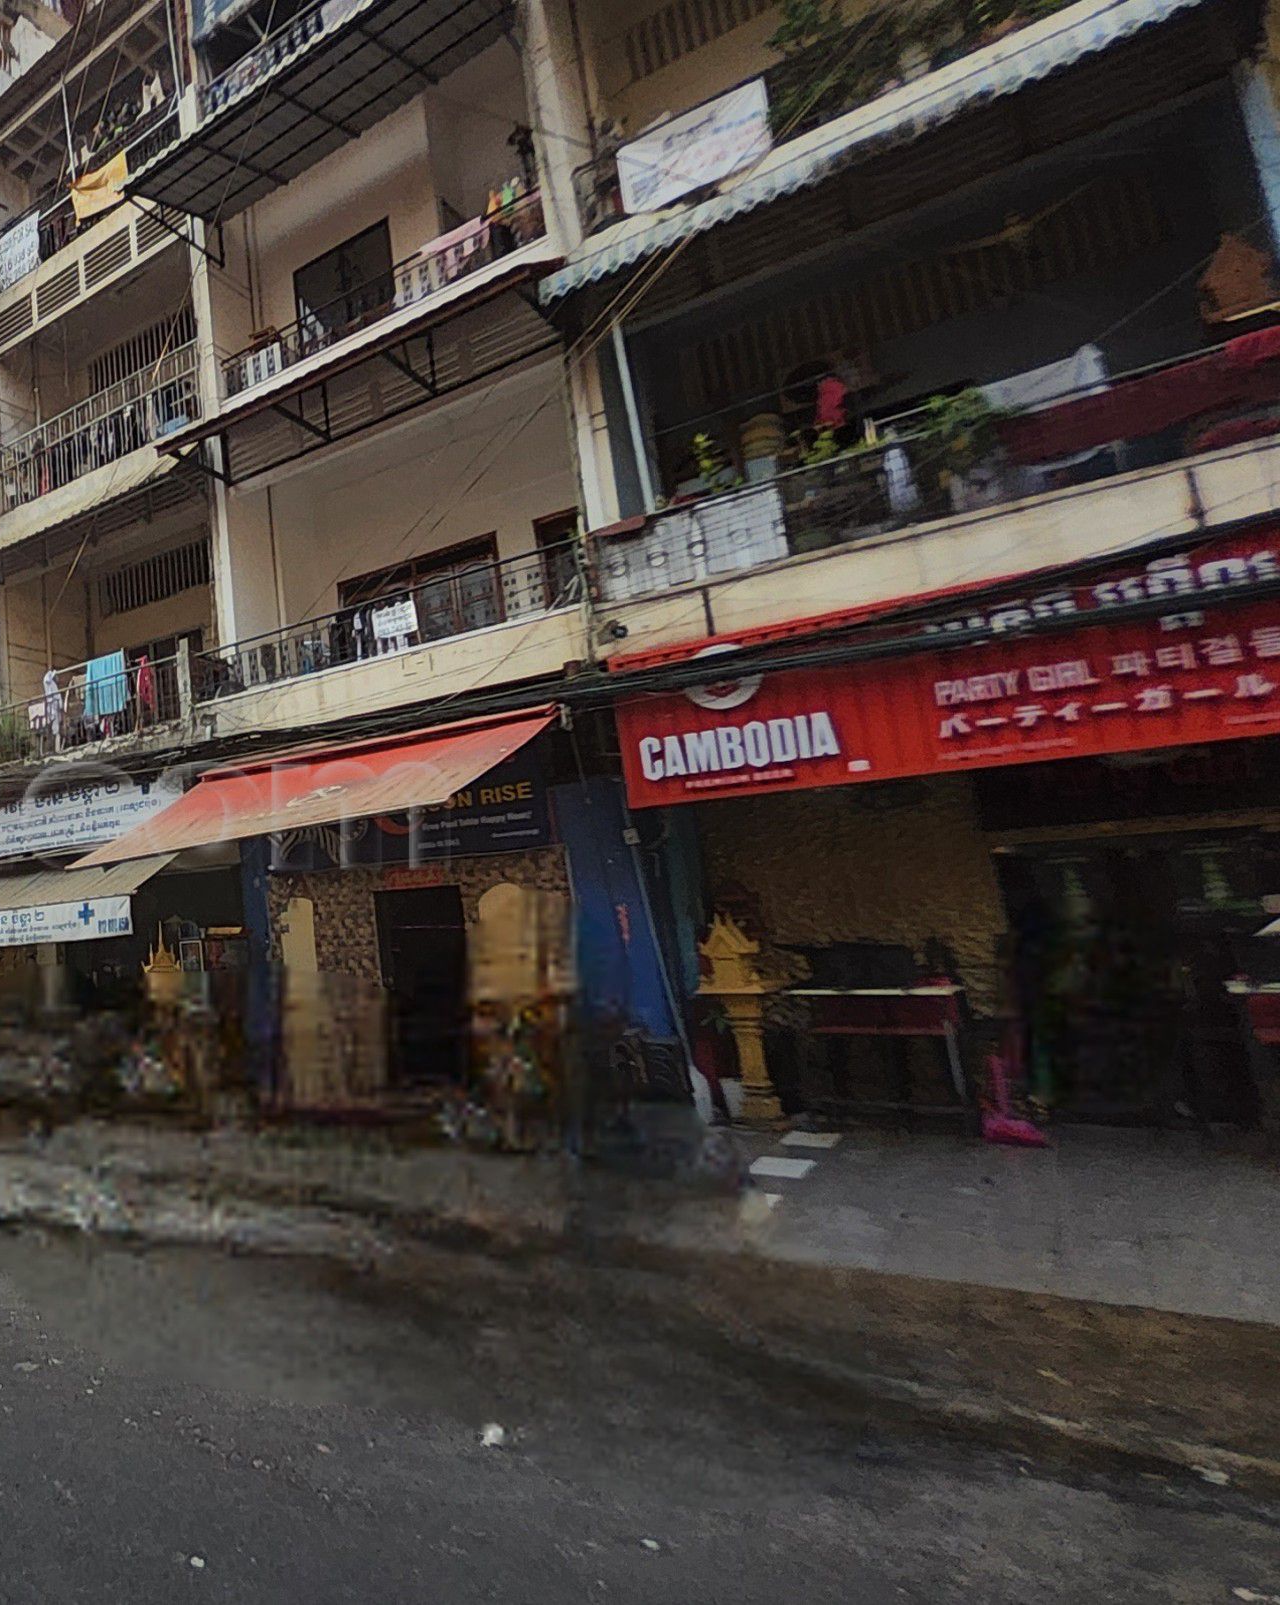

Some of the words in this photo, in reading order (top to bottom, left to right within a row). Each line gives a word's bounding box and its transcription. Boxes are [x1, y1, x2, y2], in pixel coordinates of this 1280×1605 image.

[934, 671, 1020, 706] PARTY
[1027, 660, 1102, 692] GIRL
[639, 711, 841, 781] CAMBODIA
[480, 780, 534, 805] RISE
